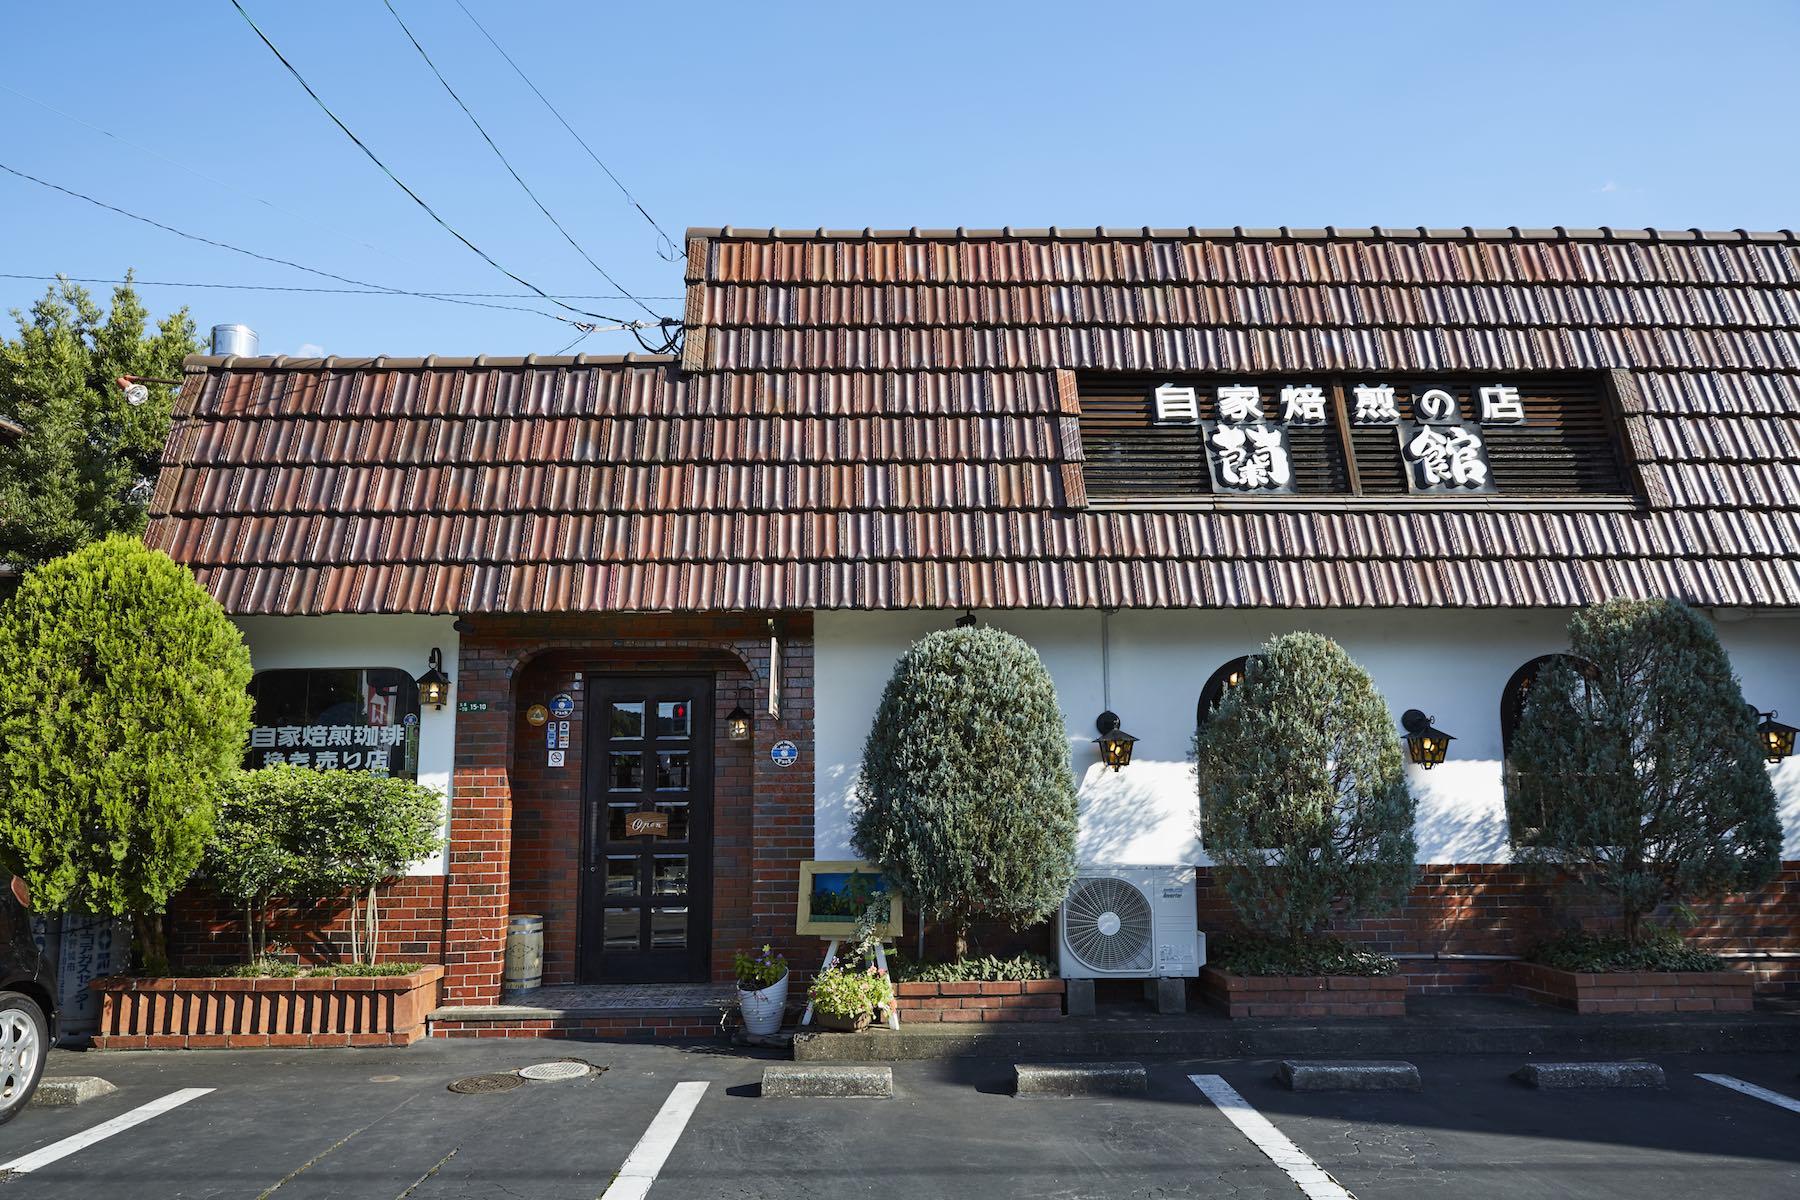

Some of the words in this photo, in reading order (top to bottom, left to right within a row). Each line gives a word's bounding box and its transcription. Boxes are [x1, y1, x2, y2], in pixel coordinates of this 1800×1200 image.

[1155, 383, 1525, 422] 自家焙煎の店
[251, 724, 405, 748] 自家焙煎珈琲
[632, 818, 662, 832] Open
